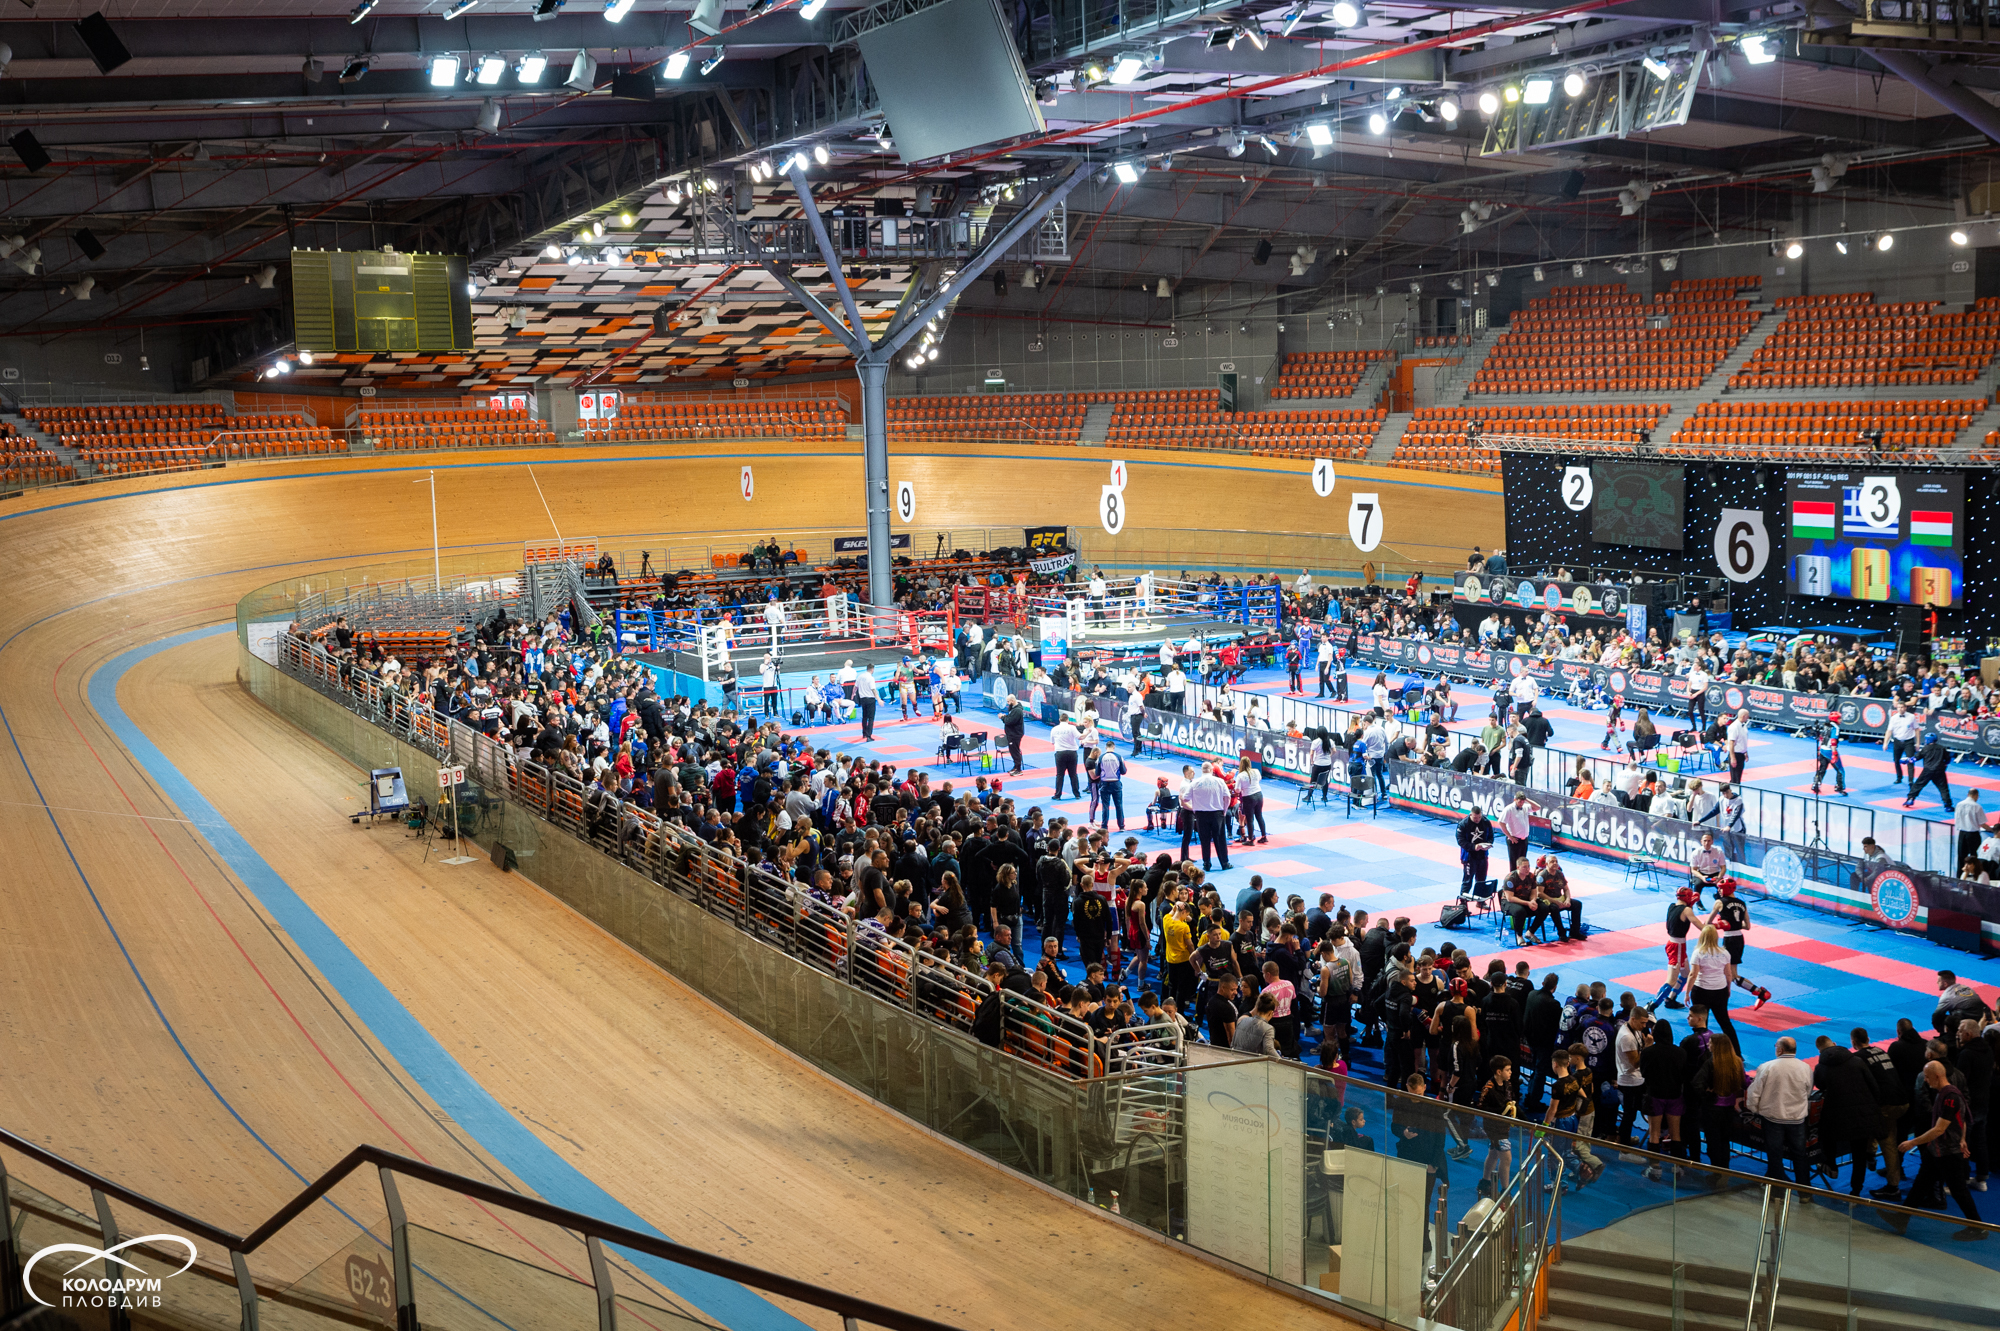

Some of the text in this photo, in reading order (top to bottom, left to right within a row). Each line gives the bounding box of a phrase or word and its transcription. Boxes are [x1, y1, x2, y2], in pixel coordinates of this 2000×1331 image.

[743, 472, 751, 497] 2
[1115, 465, 1121, 486] 1
[1317, 465, 1326, 492] 1
[1569, 474, 1584, 505] 2
[901, 487, 911, 517] 9
[1106, 493, 1119, 529] 8
[1870, 485, 1889, 522] 3
[1357, 503, 1374, 545] 7
[1610, 532, 1661, 547] LIGHTS
[1728, 521, 1755, 575] 6
[1033, 555, 1074, 573] BULTRAS
[1808, 566, 1818, 584] 2
[1865, 564, 1873, 587] 1
[1924, 578, 1935, 596] 3
[1390, 640, 1403, 650] TEN
[1774, 634, 1780, 642] 2
[1825, 635, 1830, 645] 1
[1096, 649, 1115, 658] TEN
[1433, 647, 1460, 659] TOP TEN
[1562, 663, 1577, 674] TOP
[1646, 675, 1662, 687] TEN
[1669, 679, 1686, 691] TOP
[1749, 689, 1784, 704] TOP TEN
[1792, 696, 1810, 708] TOP
[1938, 715, 1959, 728] TOP
[1158, 715, 1246, 758] Welcome
[1253, 732, 1276, 765] to
[441, 773, 449, 785] 9
[455, 770, 462, 782] 9
[1396, 772, 1463, 810] where
[1472, 790, 1505, 820] we
[349, 1262, 392, 1308] B2.3
